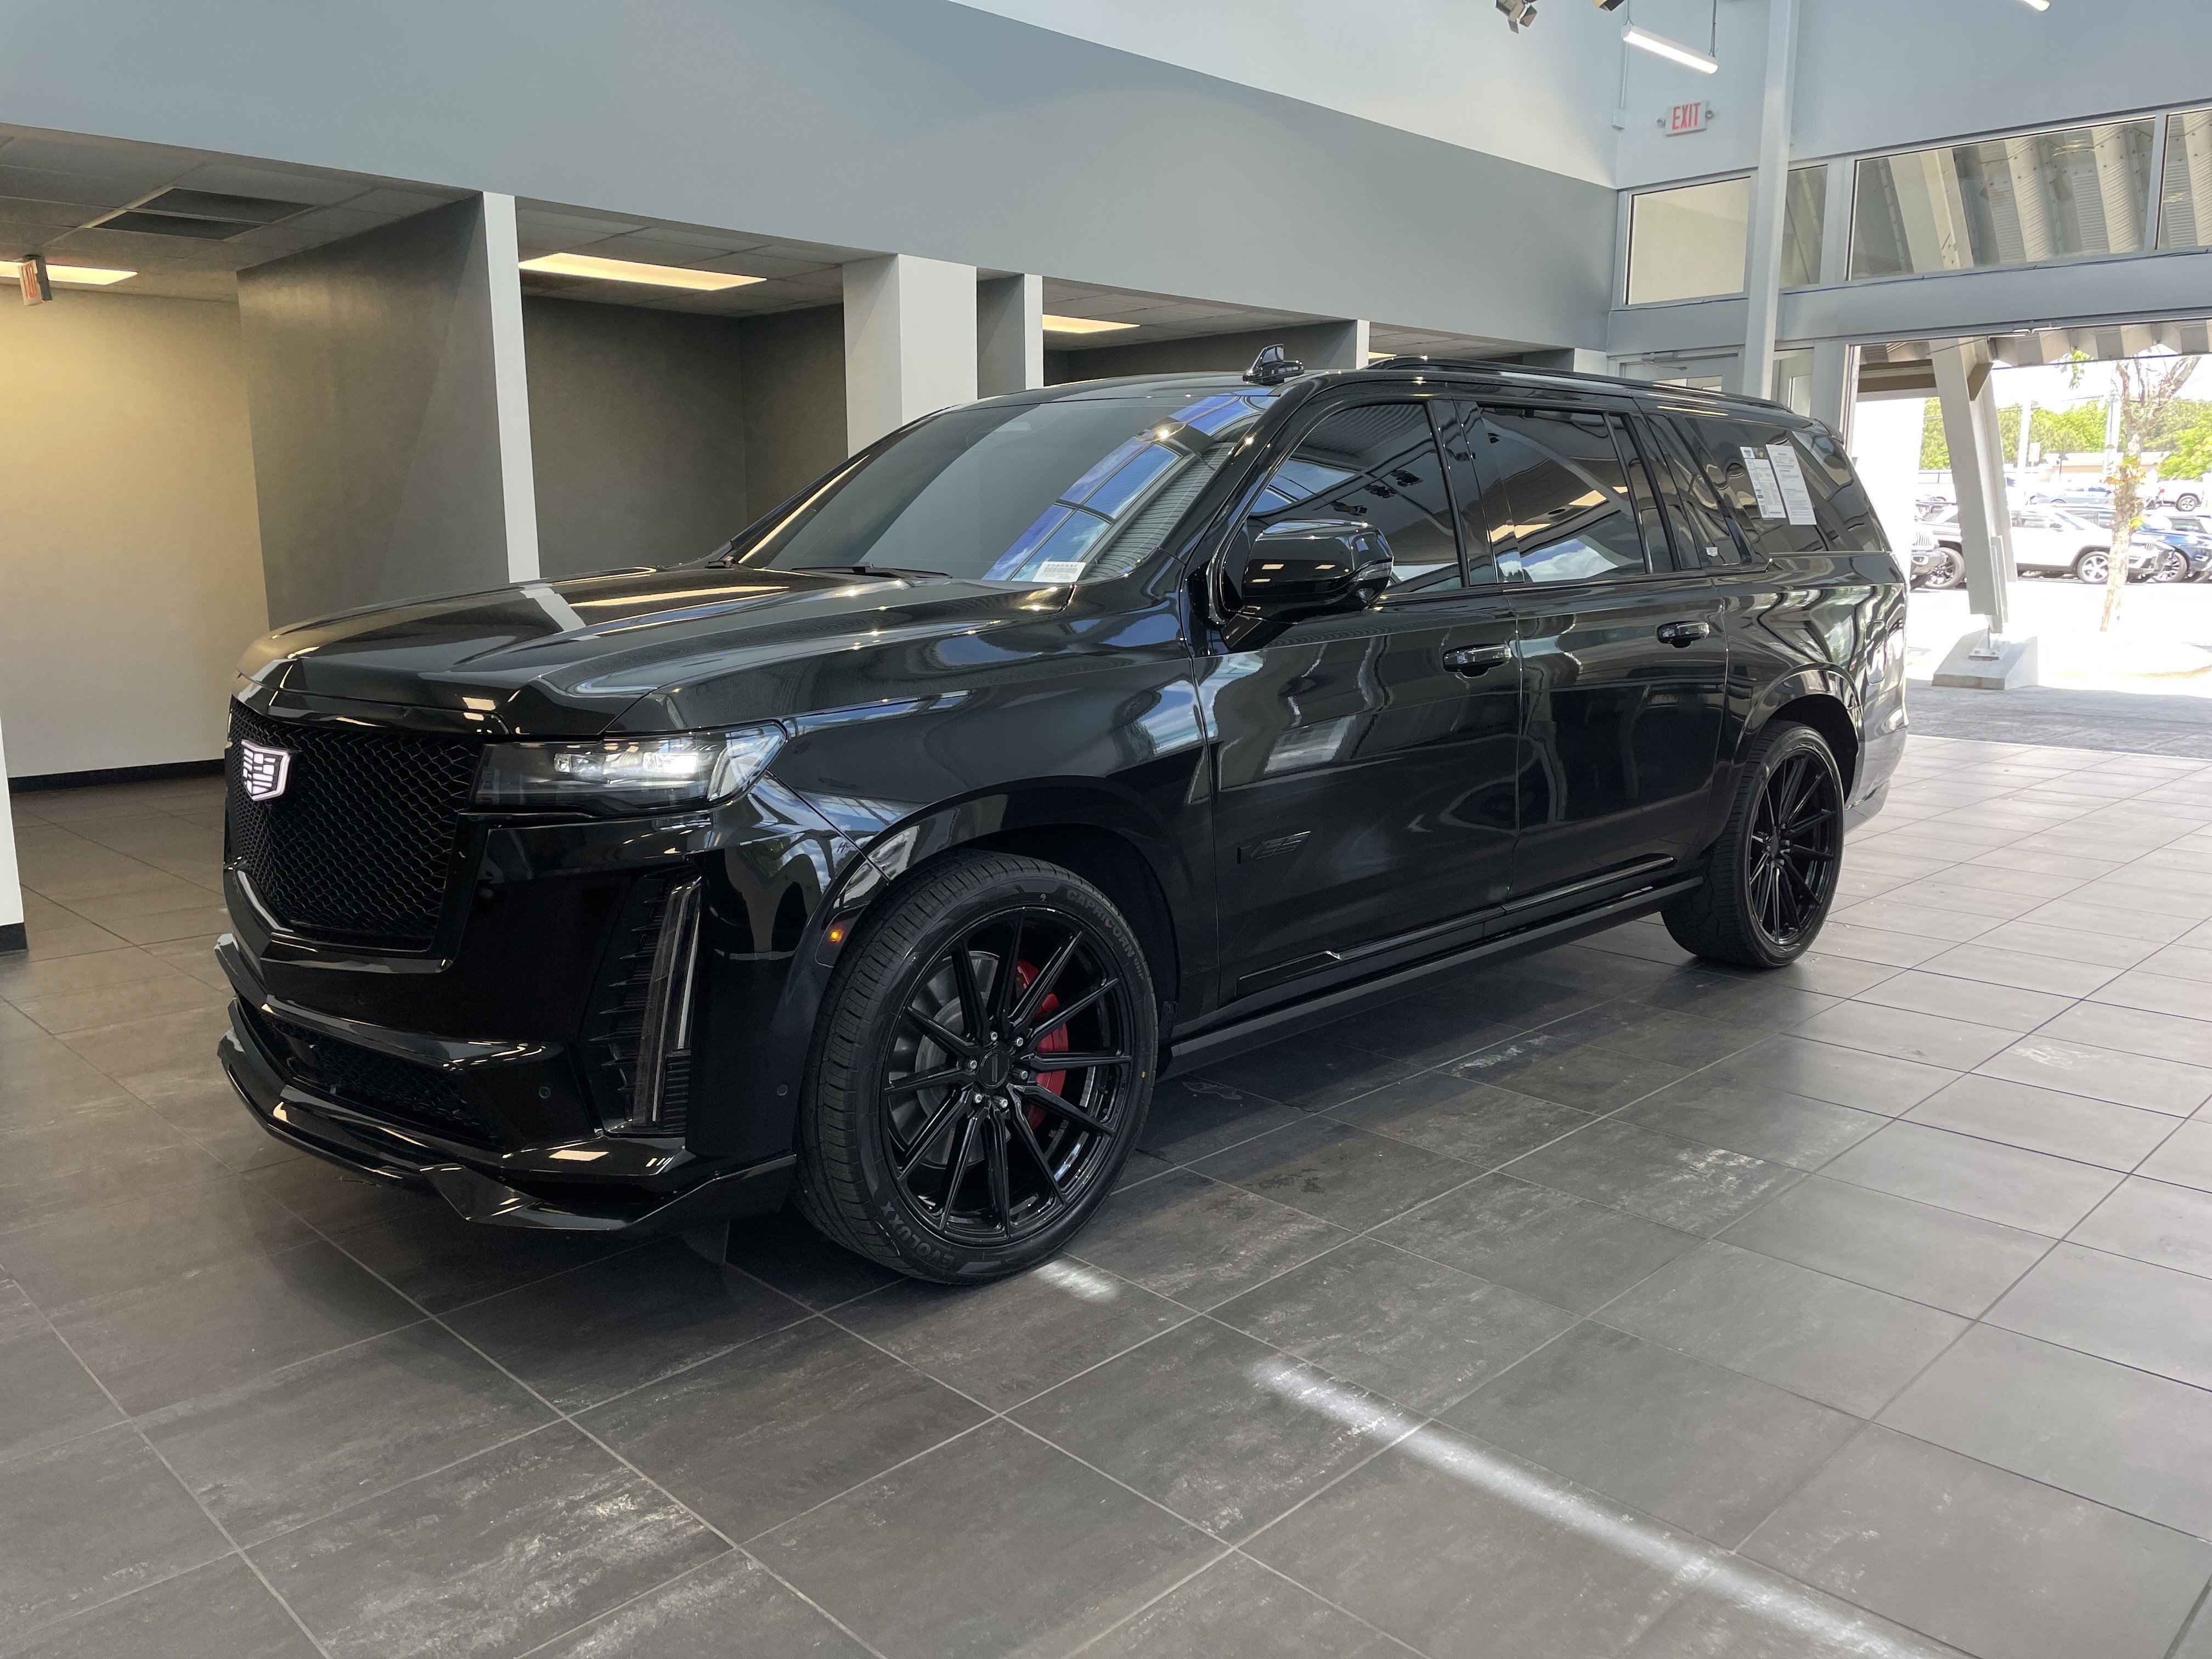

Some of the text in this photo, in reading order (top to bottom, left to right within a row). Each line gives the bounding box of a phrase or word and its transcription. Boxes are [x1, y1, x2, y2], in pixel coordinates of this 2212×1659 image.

[1672, 101, 1701, 130] EXIT
[1067, 890, 1135, 957] CAPRICORN
[879, 1201, 955, 1268] EVOLUXX
